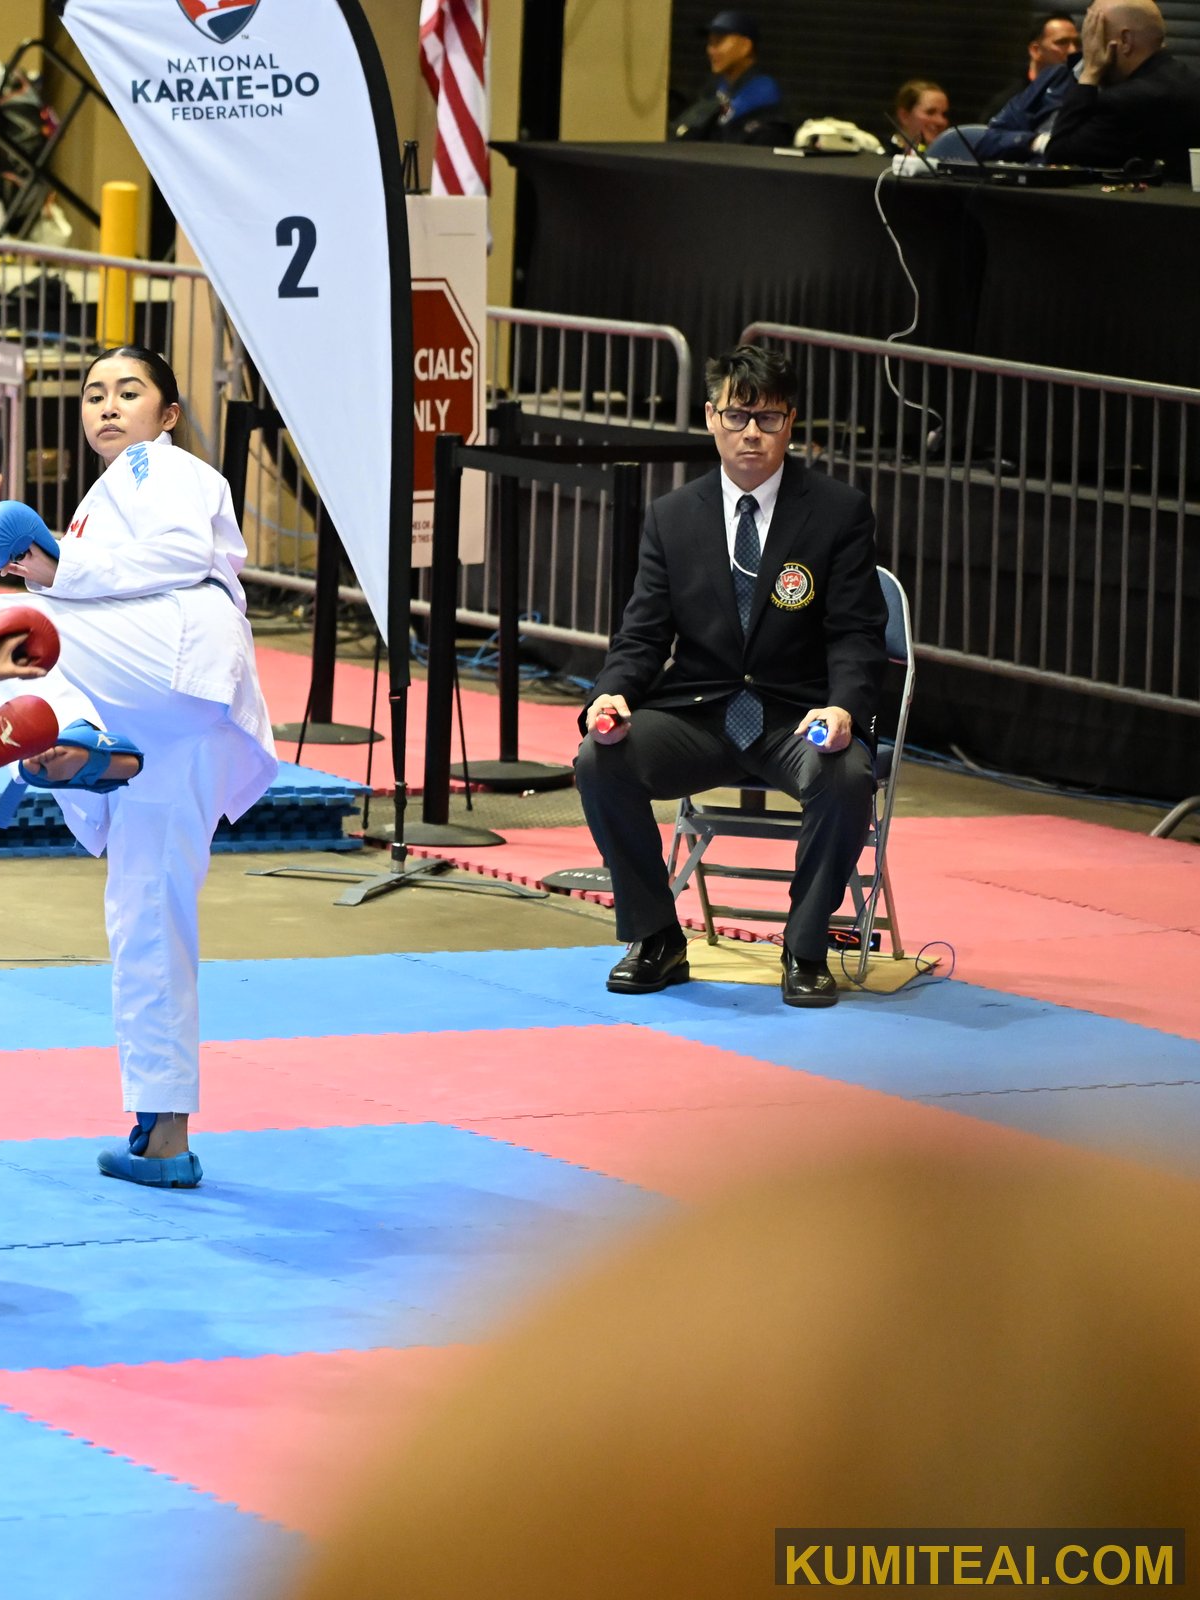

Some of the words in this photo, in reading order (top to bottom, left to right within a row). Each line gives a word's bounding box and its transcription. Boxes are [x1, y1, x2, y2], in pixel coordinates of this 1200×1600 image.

[167, 53, 279, 74] NATIONAL
[131, 72, 320, 104] KARATE-DO
[171, 103, 283, 121] FEDERATION
[275, 215, 319, 299] 2
